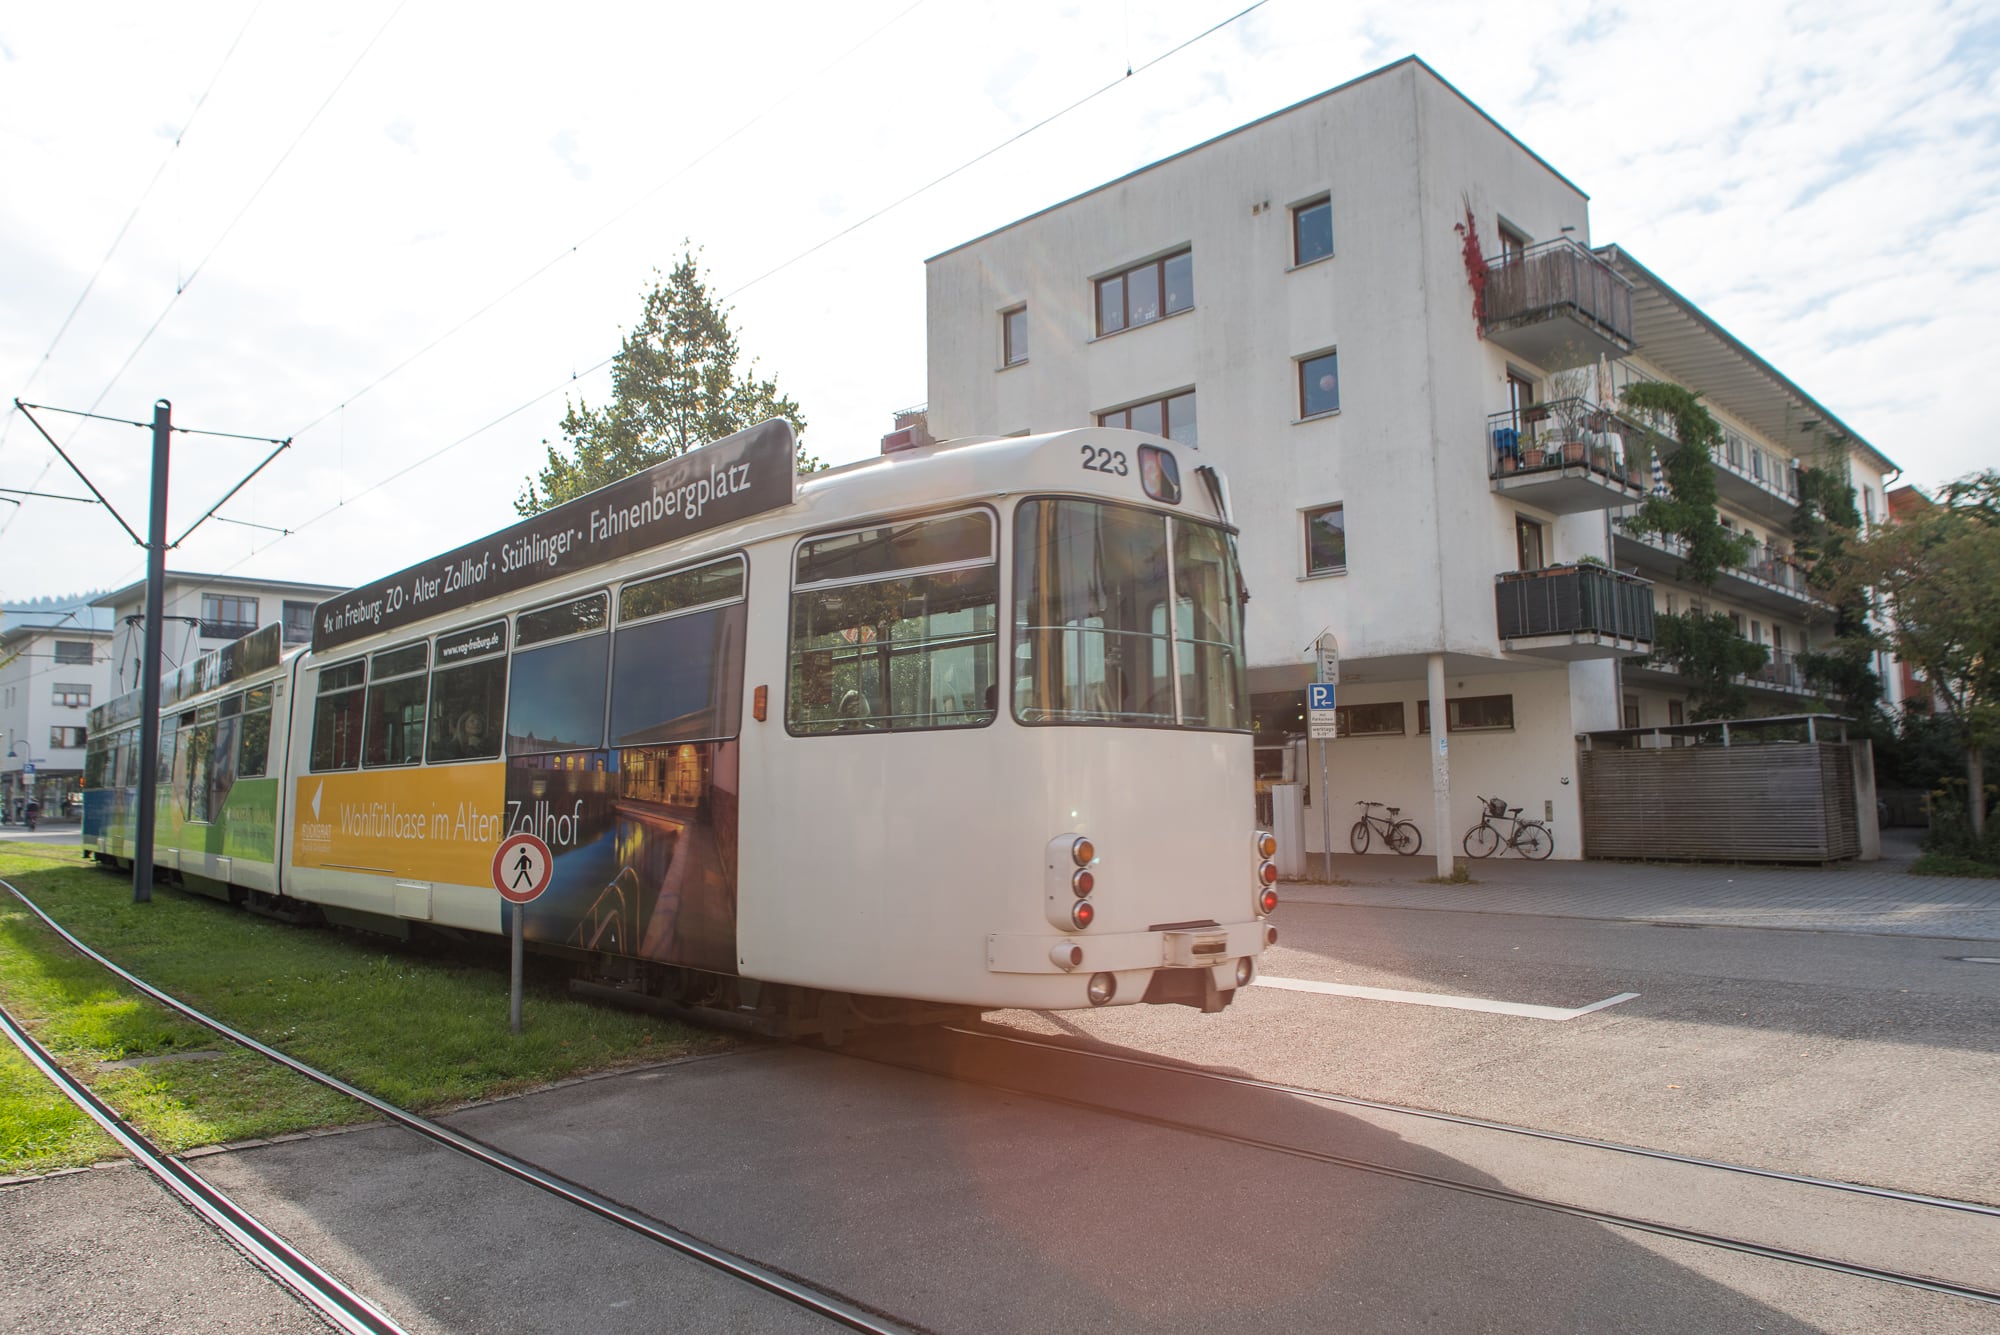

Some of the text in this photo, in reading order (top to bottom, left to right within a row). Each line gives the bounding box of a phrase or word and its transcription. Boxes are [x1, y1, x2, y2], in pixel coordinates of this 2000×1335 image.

[1081, 444, 1128, 477] 223
[323, 462, 751, 634] 4x in Freiburg: ZO Alter Zollhof Stühlinger Fahnenbergplatz
[1313, 686, 1328, 707] P
[340, 799, 584, 846] Wohlfühloase im Alten Zollhof
